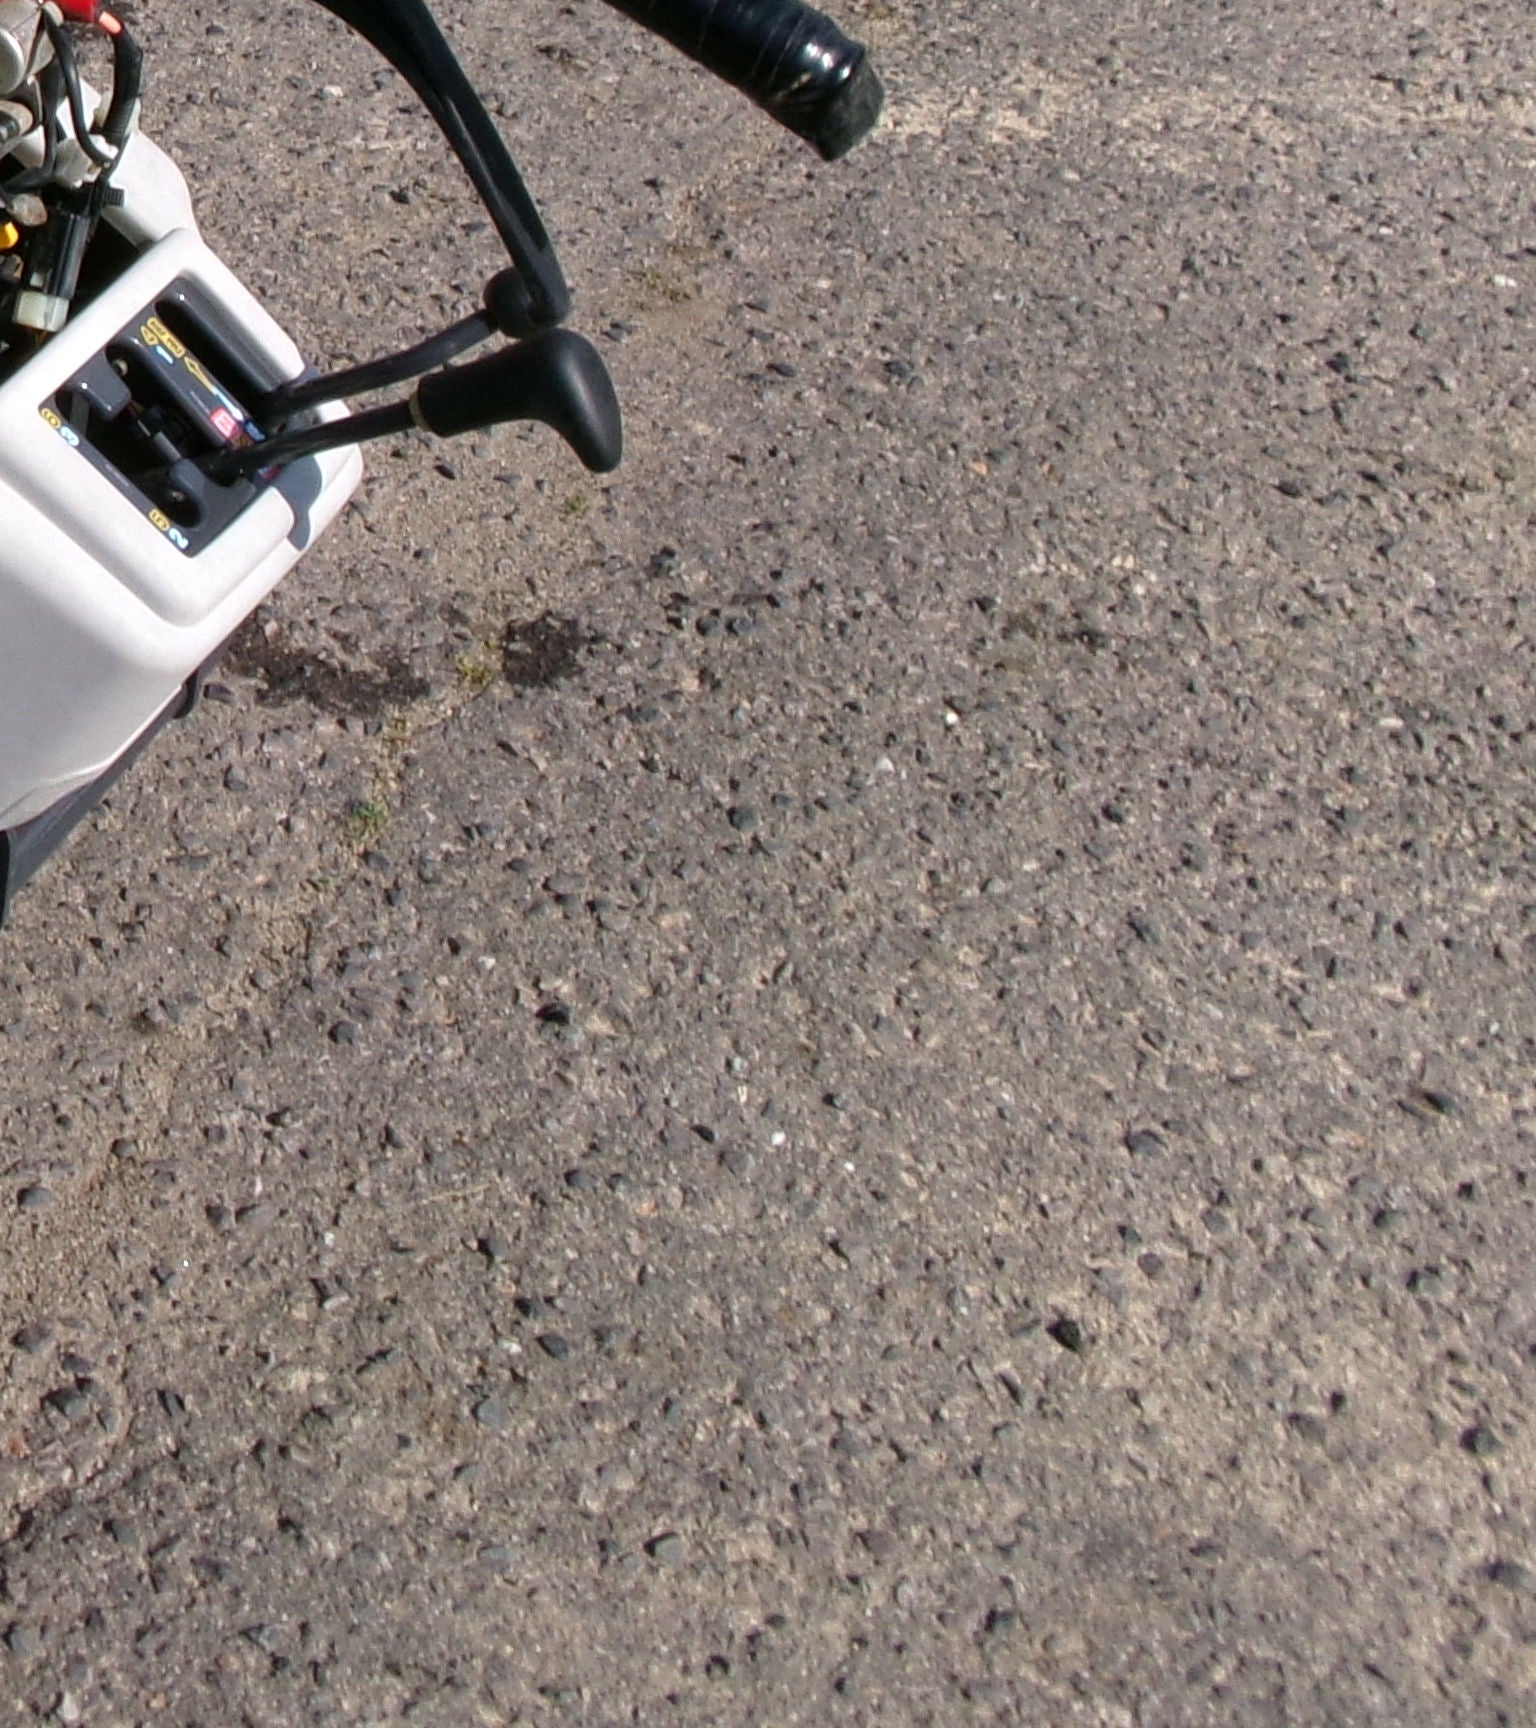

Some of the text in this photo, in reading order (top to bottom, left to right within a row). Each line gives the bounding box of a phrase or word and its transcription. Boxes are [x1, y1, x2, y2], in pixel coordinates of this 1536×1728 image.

[156, 345, 174, 365] 1
[41, 407, 61, 429] 6
[60, 426, 80, 446] 3
[168, 528, 189, 550] 2
